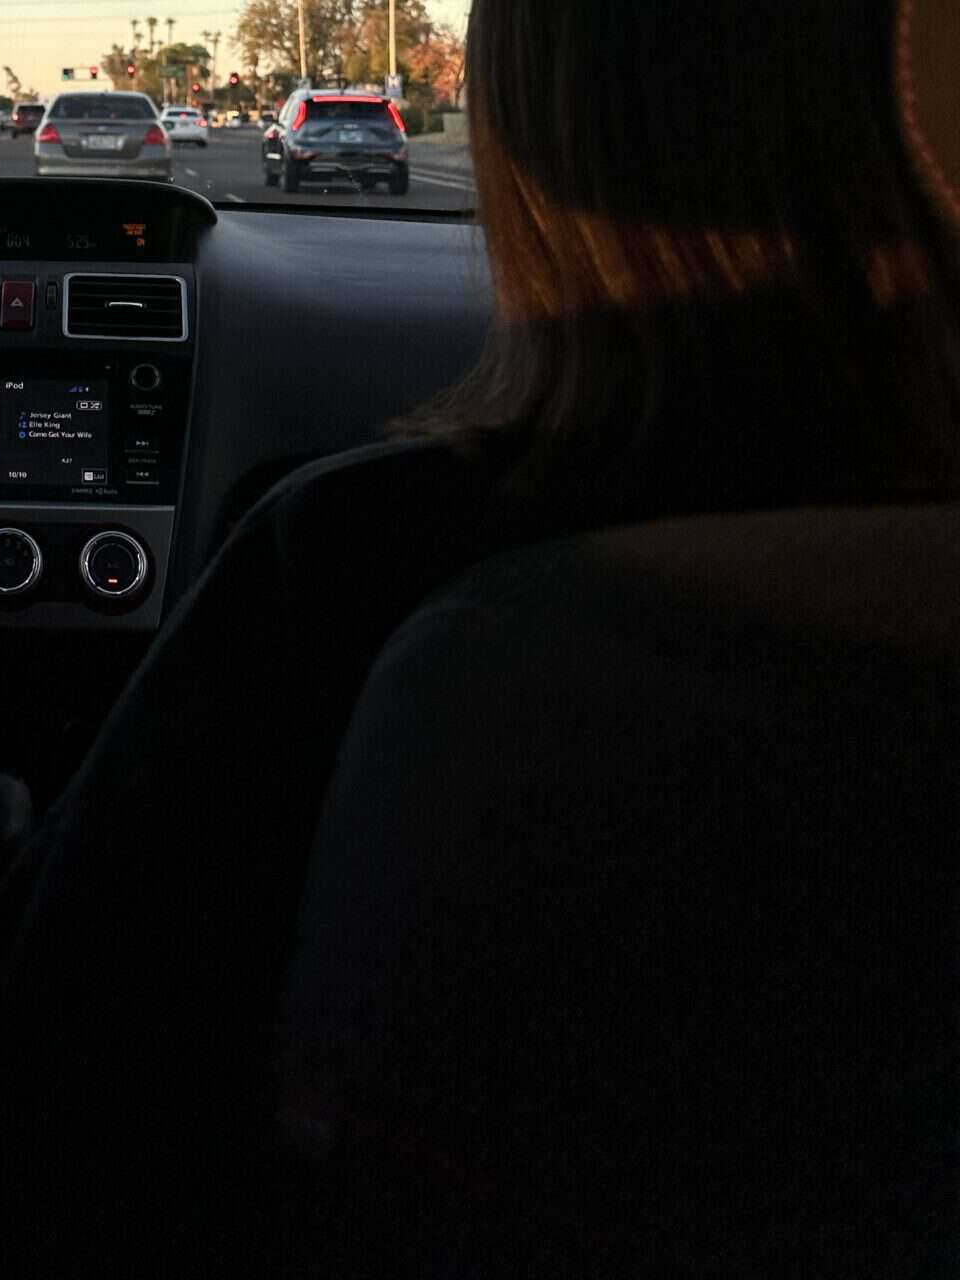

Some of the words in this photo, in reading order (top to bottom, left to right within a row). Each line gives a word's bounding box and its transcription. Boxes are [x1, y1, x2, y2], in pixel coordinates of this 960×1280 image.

[5, 381, 24, 390] iPod
[29, 412, 51, 420] Jersey
[44, 421, 60, 430] King
[76, 431, 93, 439] Wife
[8, 471, 27, 479] 10/10
